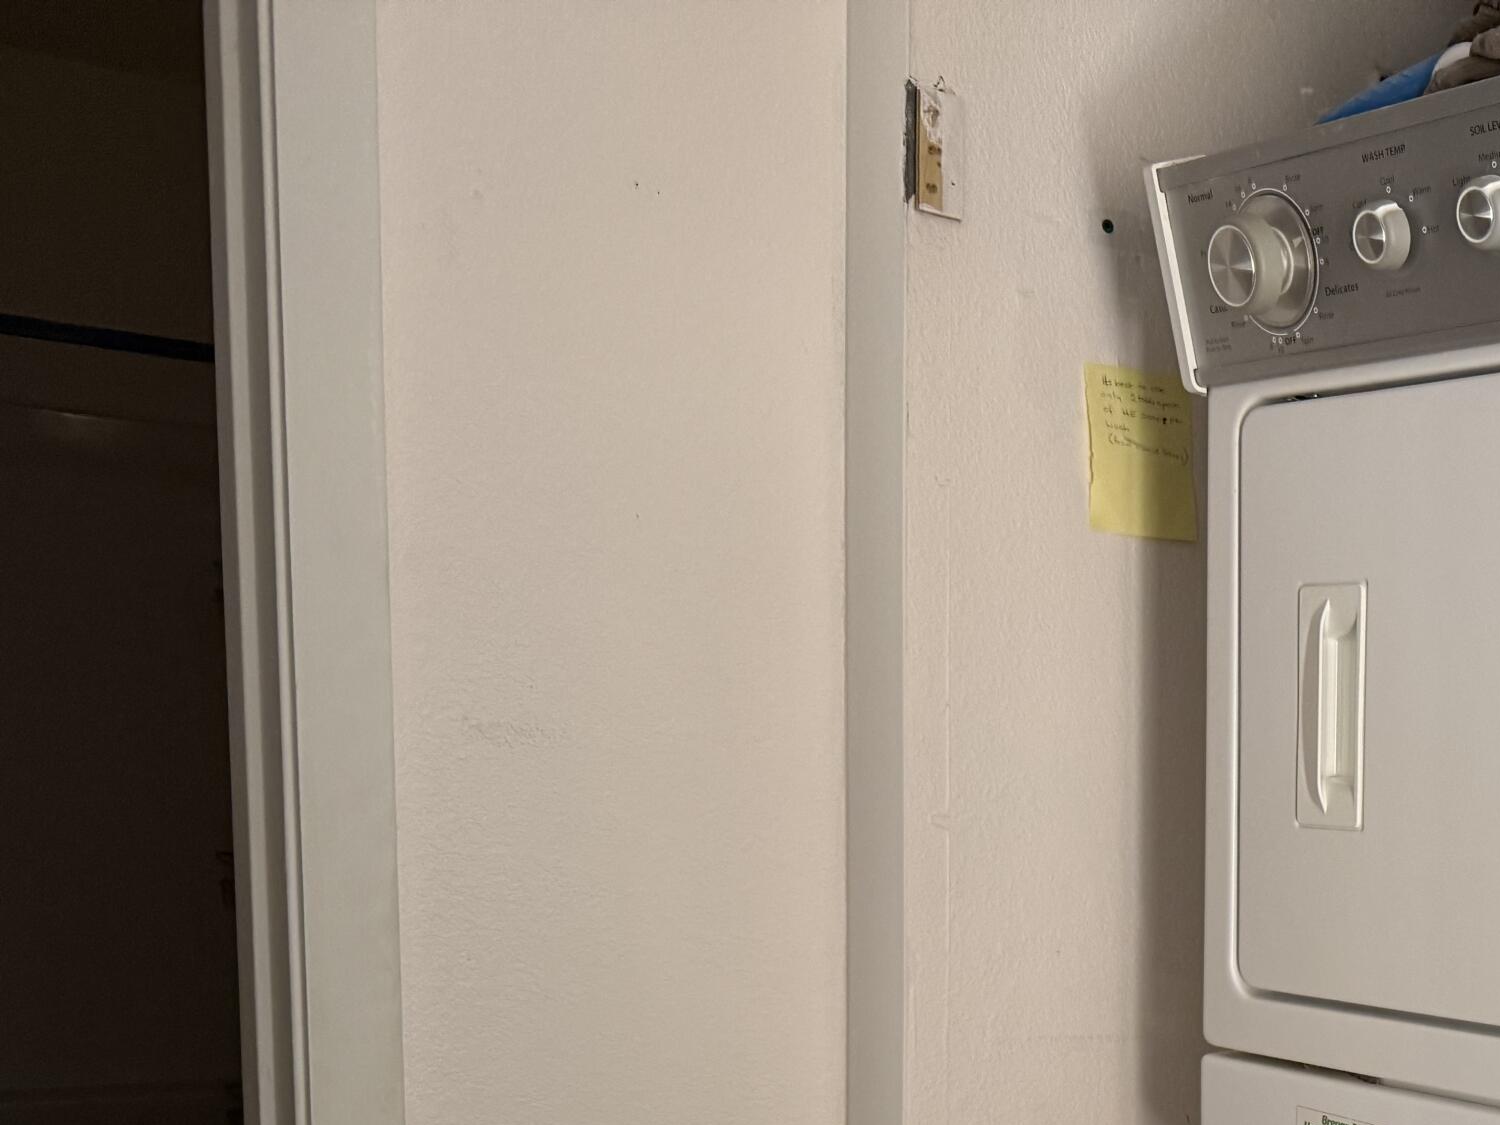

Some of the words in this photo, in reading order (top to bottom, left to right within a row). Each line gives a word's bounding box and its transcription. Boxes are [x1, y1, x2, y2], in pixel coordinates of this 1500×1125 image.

[1470, 124, 1485, 136] SOIL
[1362, 149, 1385, 163] WASH
[1386, 144, 1406, 157] TEMP
[1188, 190, 1213, 204] Normal
[1325, 283, 1359, 296] Delicates
